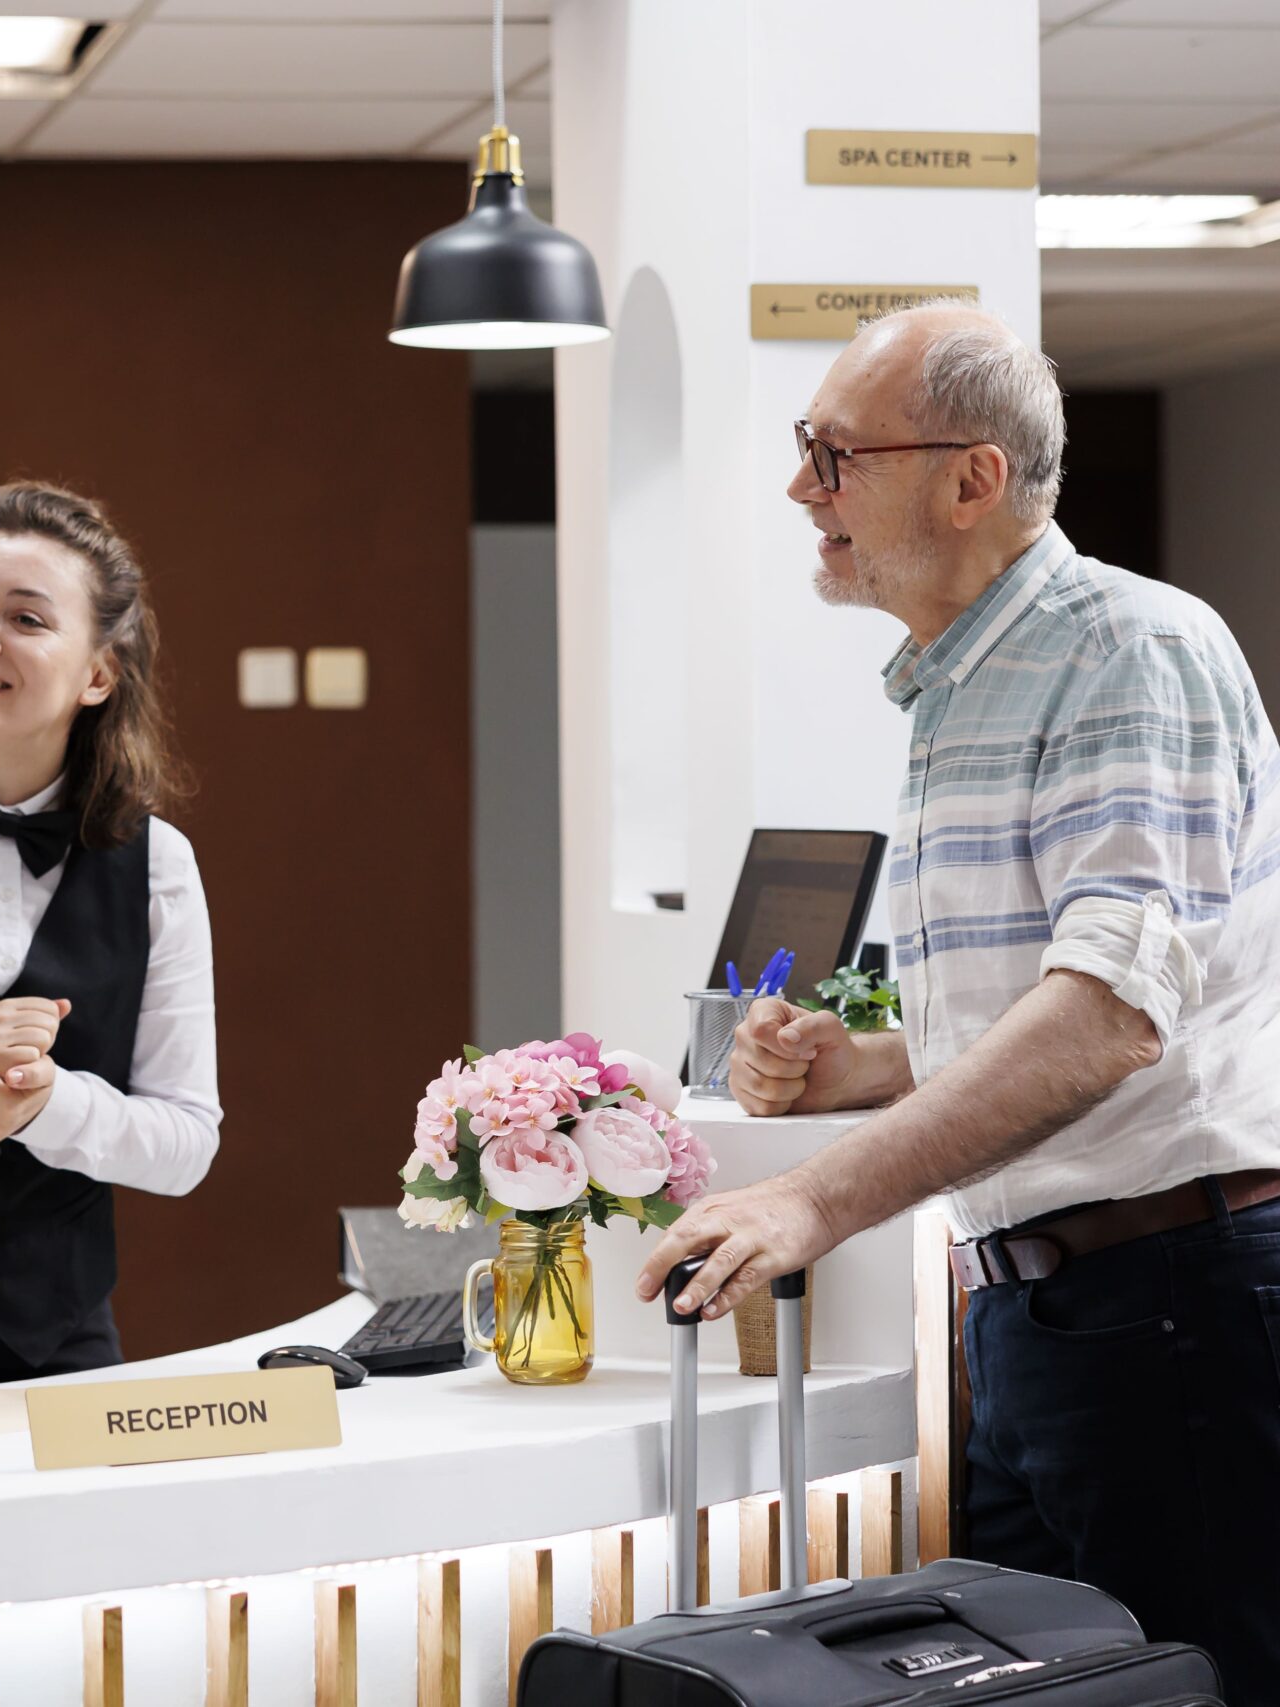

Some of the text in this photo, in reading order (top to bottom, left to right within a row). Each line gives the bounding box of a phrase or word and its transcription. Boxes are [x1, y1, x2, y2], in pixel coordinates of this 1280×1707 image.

[839, 148, 971, 169] SPA CENTER
[106, 1399, 269, 1435] RECEPTION
